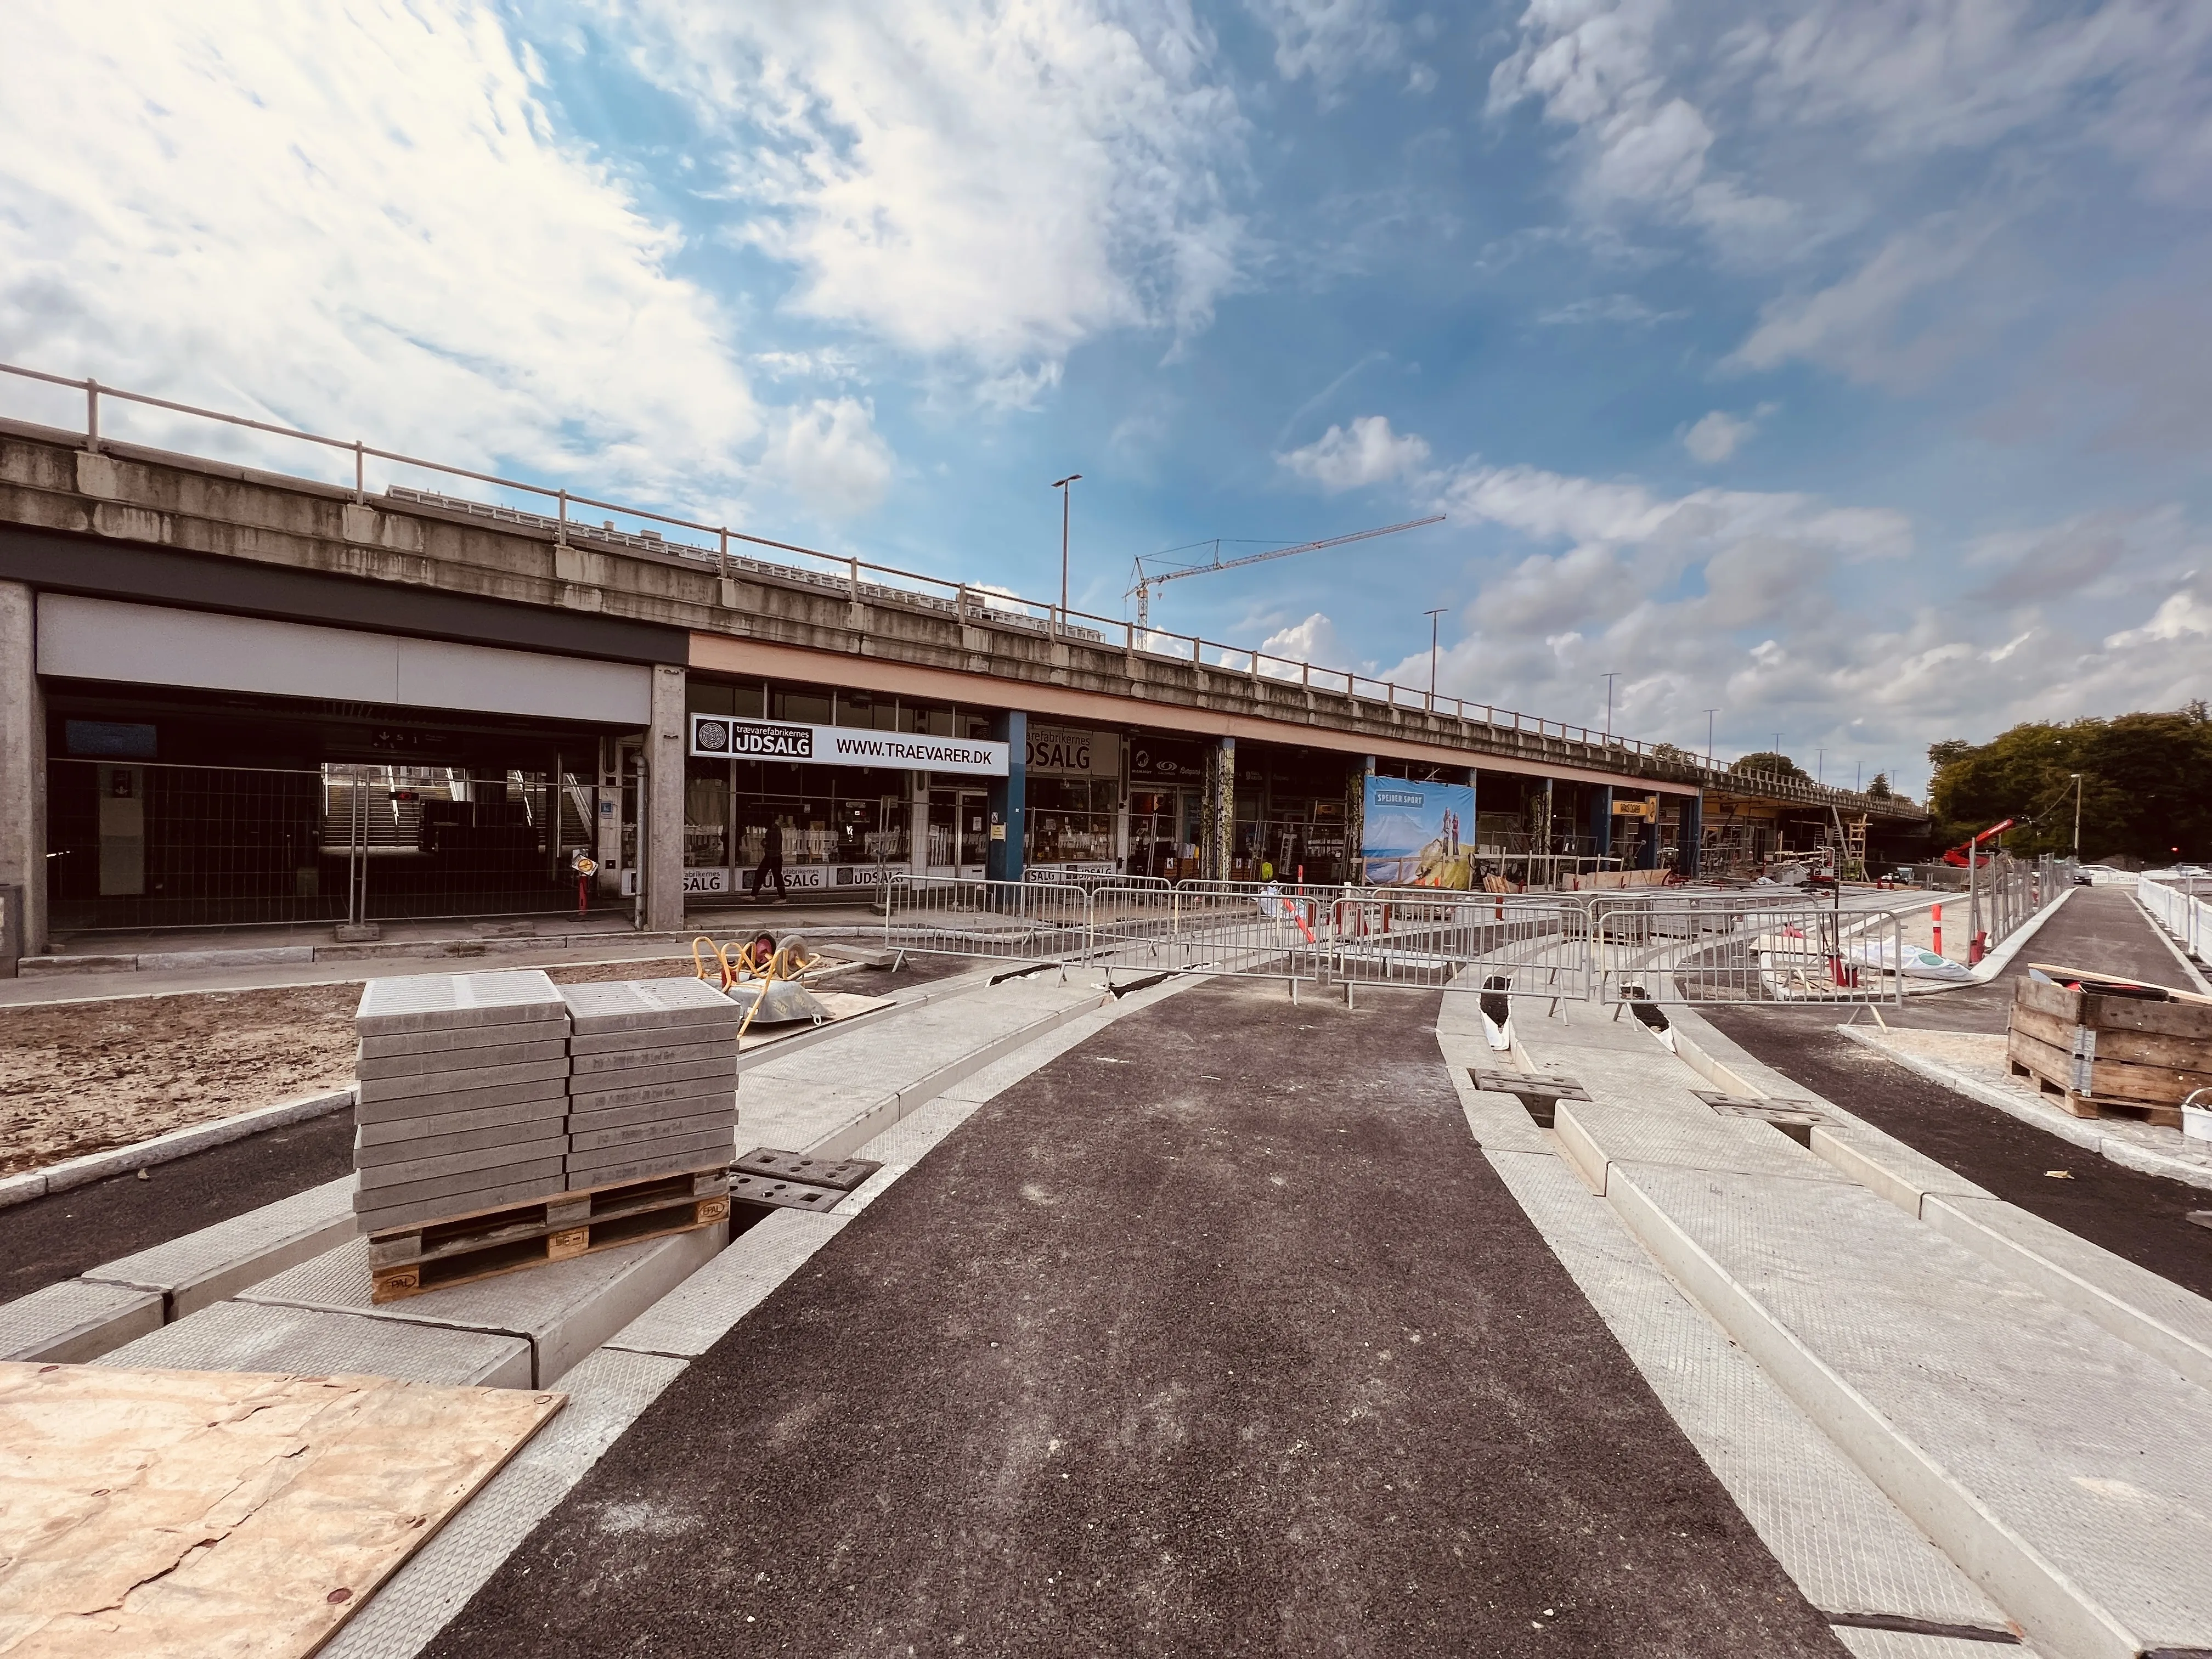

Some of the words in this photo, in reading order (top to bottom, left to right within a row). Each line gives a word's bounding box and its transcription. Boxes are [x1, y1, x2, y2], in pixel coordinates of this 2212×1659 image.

[736, 725, 809, 738] trævarefabrikernes
[736, 734, 810, 755] UDSALG
[836, 738, 992, 765] WWW.TRAEVARER.DK
[1403, 795, 1423, 804] SPORT
[763, 873, 819, 888] USALG
[703, 1205, 719, 1216] EPAL
[387, 1277, 411, 1288] PAL
